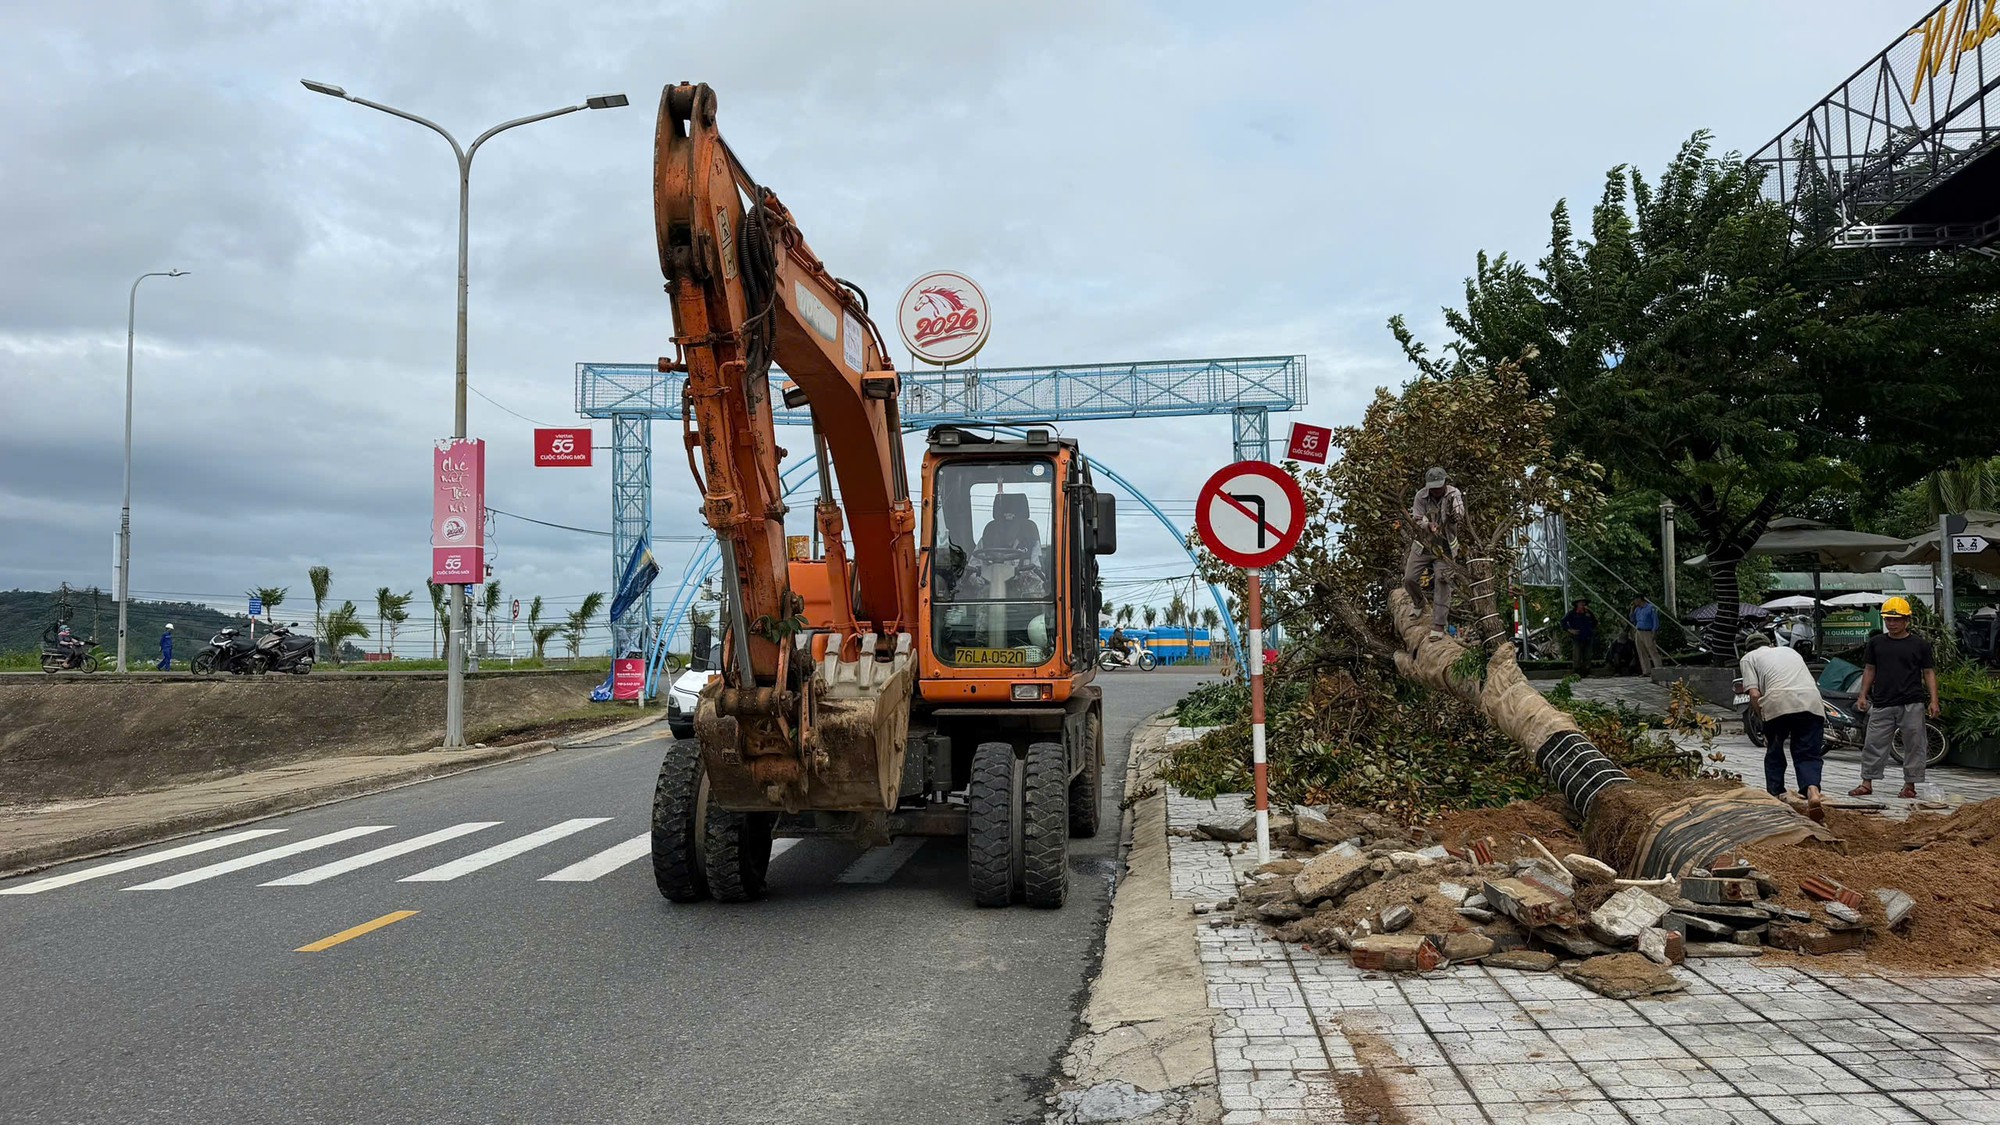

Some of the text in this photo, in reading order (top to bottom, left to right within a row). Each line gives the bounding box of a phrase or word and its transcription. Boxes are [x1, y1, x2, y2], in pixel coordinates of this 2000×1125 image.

[1908, 0, 2000, 104] Mak
[914, 308, 979, 341] 2026
[552, 439, 574, 453] 5G
[1302, 434, 1319, 450] 5G
[447, 526, 464, 536] 2026
[445, 558, 461, 570] 5G
